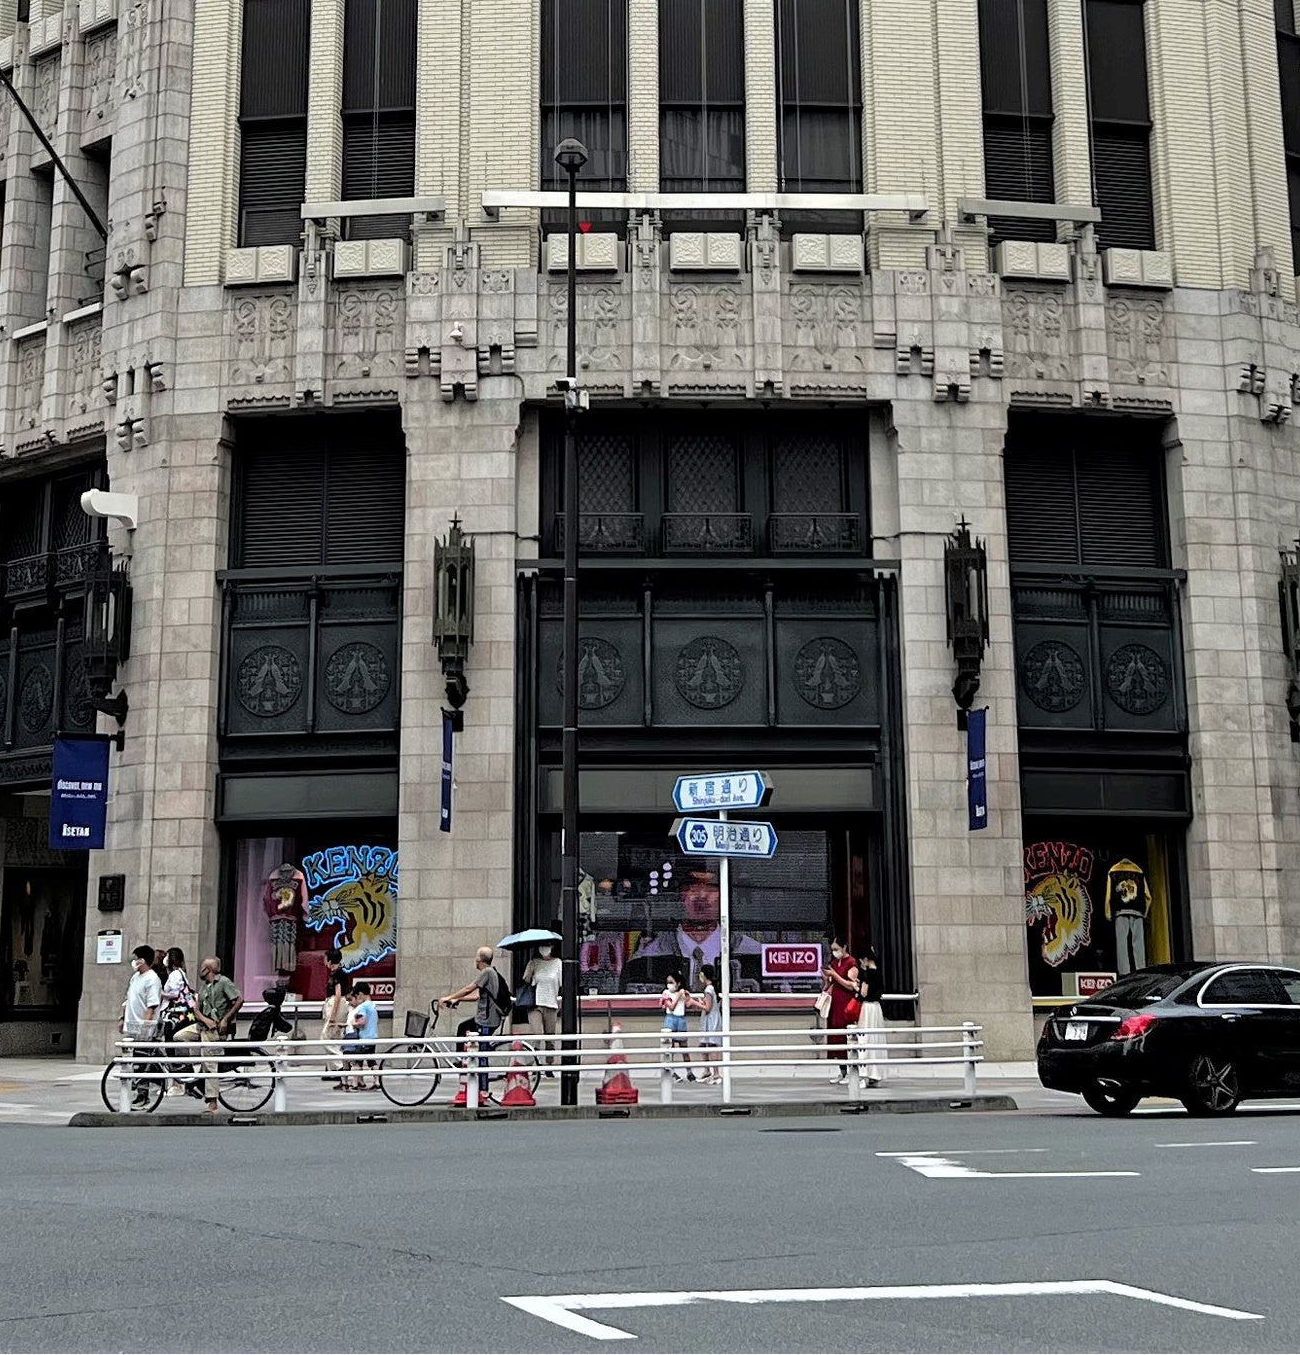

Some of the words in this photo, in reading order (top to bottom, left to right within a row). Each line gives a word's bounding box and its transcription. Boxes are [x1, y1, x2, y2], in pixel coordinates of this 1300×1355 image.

[689, 777, 748, 797] 新宿通り
[691, 829, 707, 843] 305
[713, 825, 762, 843] 明治通り
[768, 951, 816, 964] KENZO
